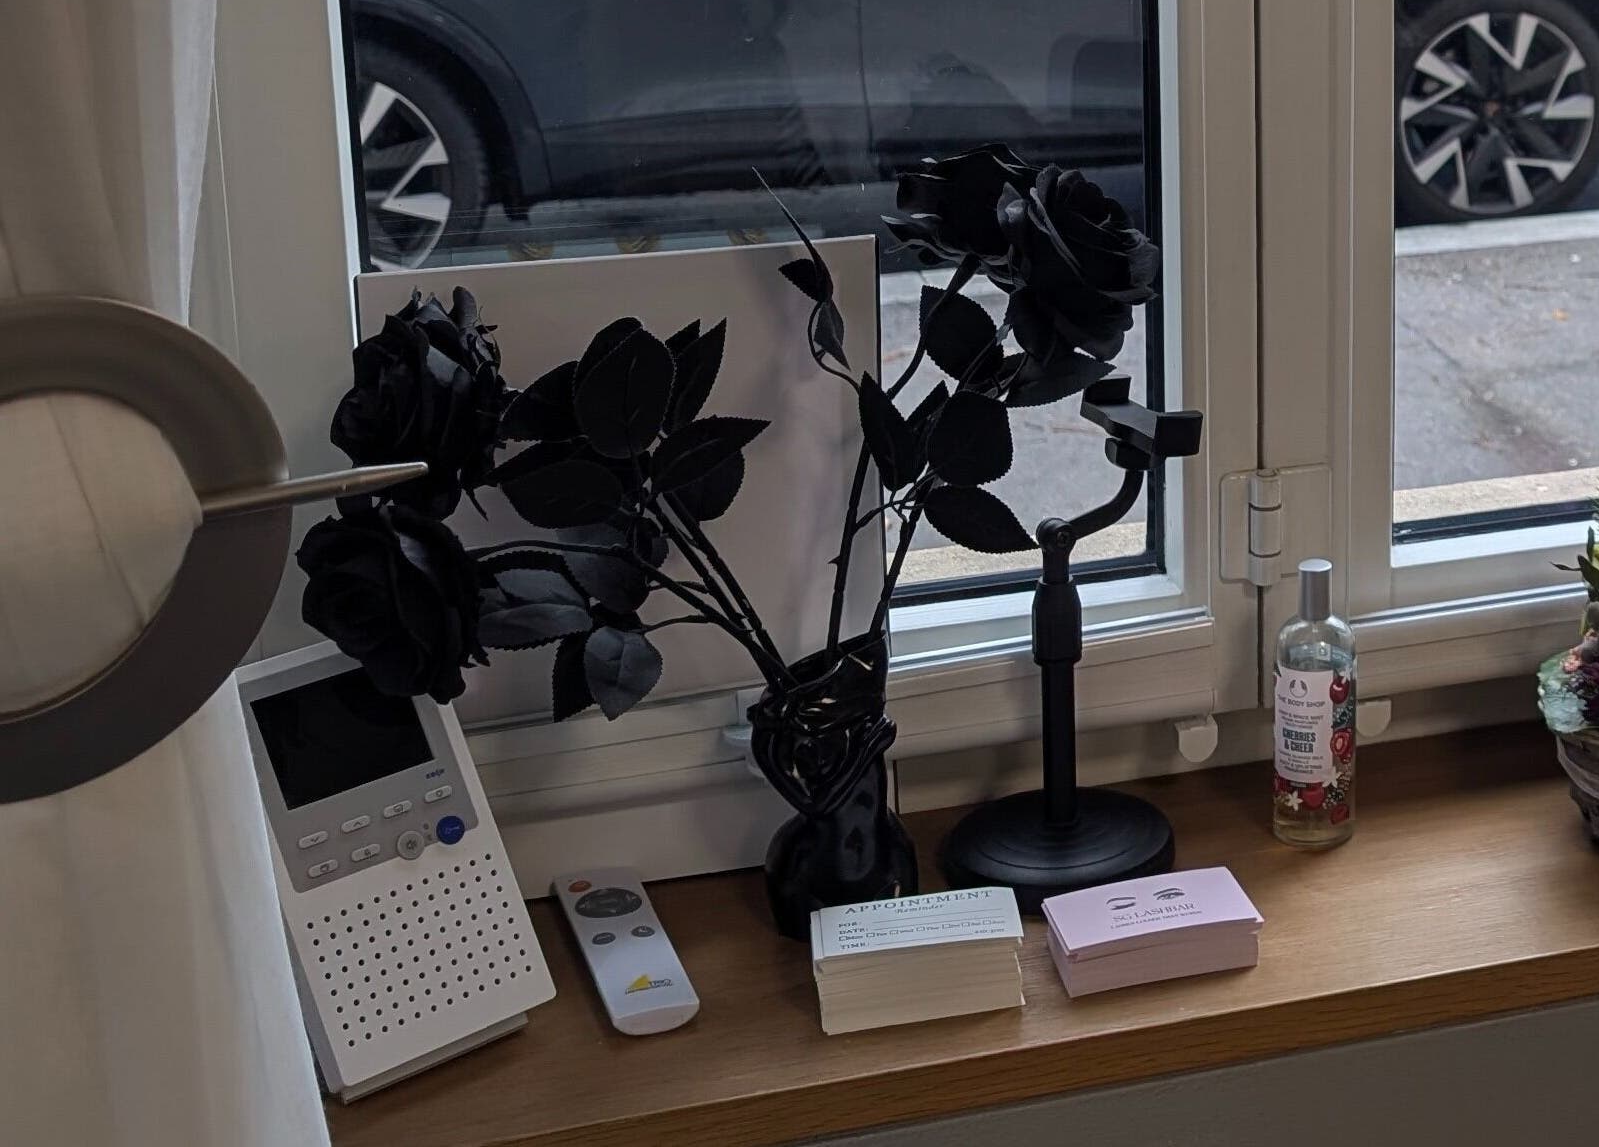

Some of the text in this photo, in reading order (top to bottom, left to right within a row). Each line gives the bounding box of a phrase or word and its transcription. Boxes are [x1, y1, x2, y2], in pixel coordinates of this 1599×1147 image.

[1287, 698, 1304, 707] BODY
[1282, 727, 1316, 743] CHERRIES
[1290, 741, 1314, 753] CHEER
[845, 889, 993, 915] APPOINTMENT
[894, 903, 944, 915] Reminder
